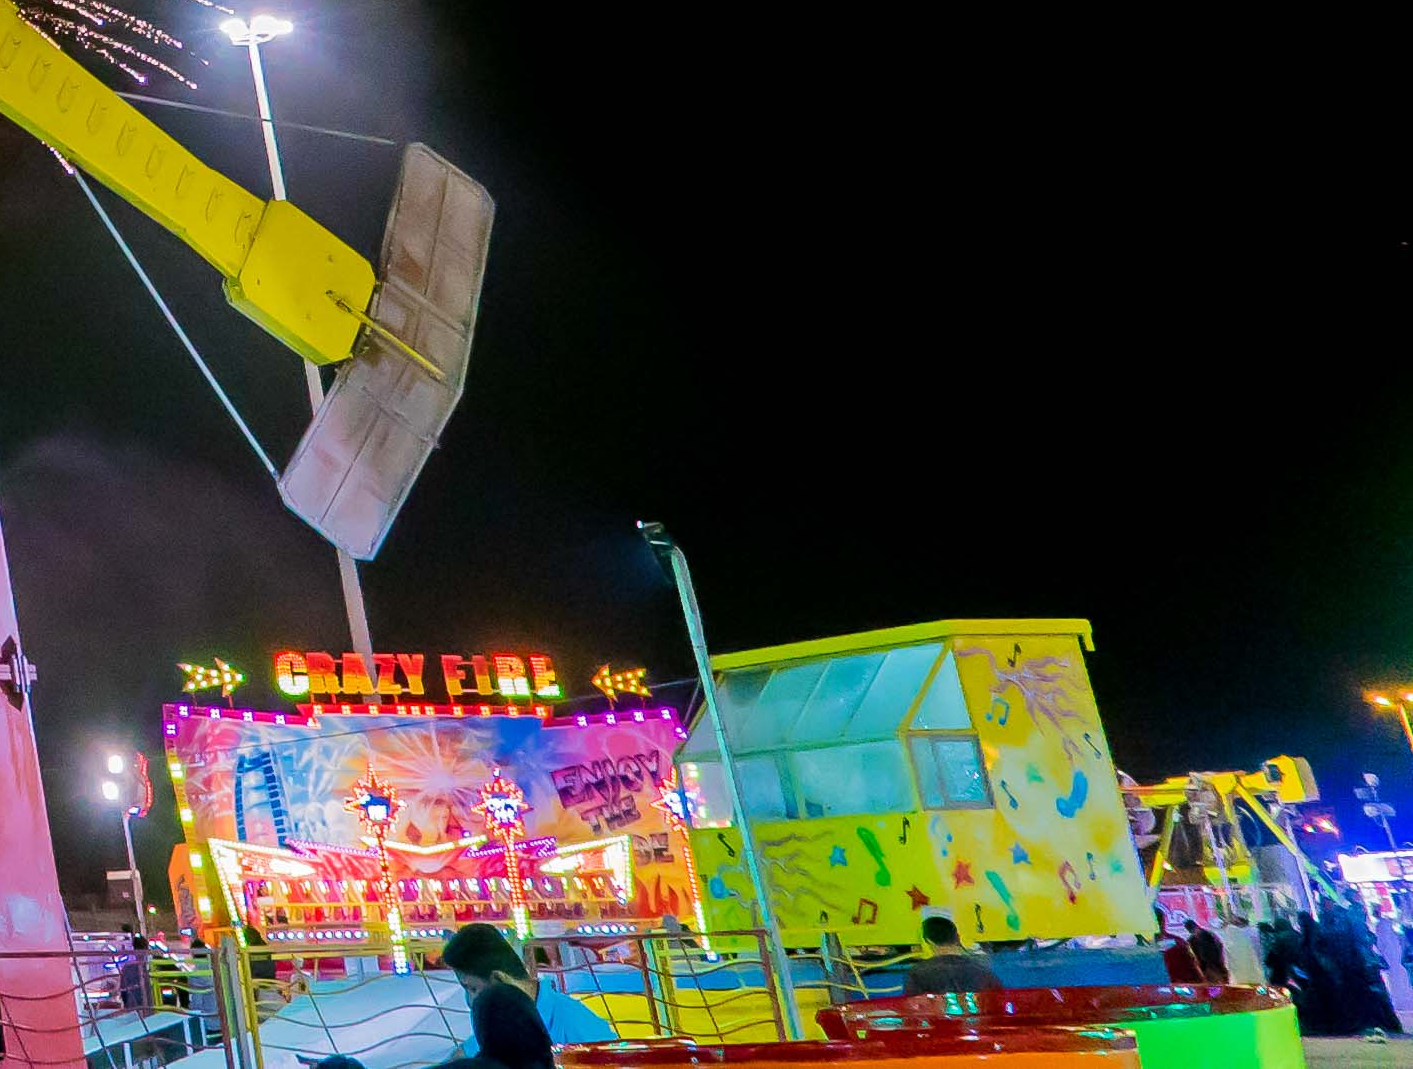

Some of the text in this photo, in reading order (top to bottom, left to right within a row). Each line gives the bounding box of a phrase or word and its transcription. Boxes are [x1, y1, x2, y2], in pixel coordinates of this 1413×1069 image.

[275, 651, 562, 698] CRAZY FIRE
[549, 748, 662, 811] ENJOY
[580, 794, 642, 835] THE
